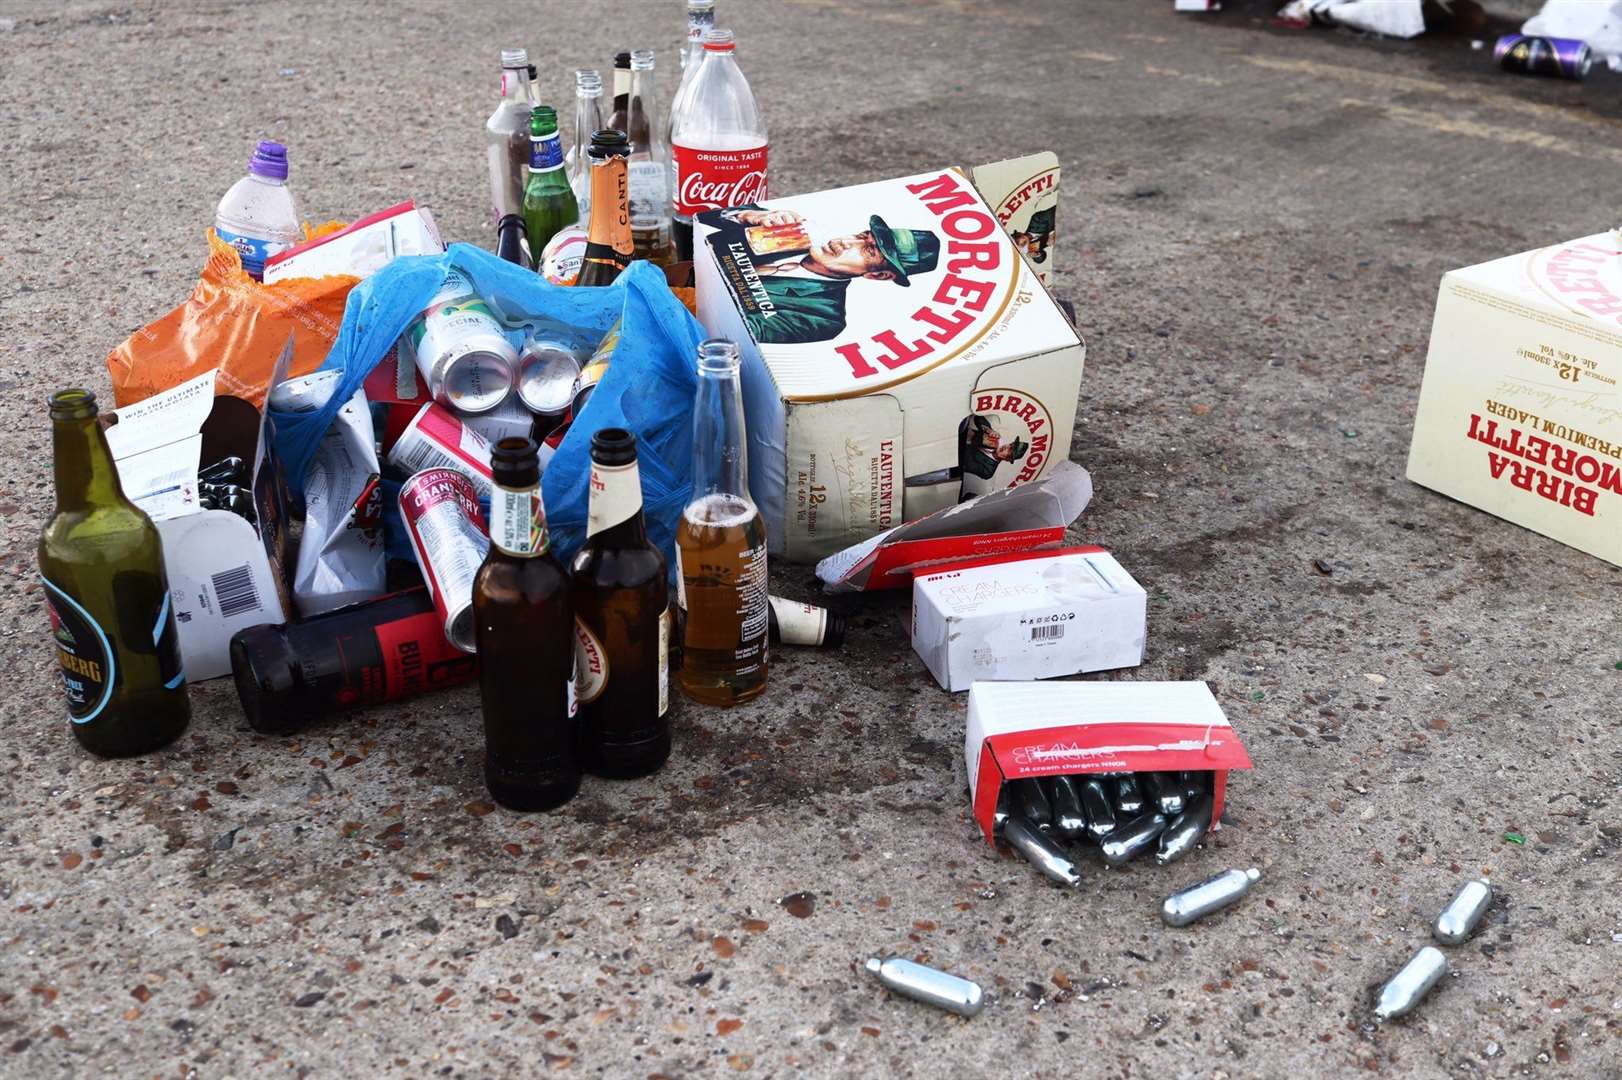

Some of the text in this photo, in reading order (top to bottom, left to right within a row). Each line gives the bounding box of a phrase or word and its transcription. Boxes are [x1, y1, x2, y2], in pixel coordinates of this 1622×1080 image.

[696, 152, 762, 162] ORIGINAL TASTE
[618, 173, 628, 226] CANTI
[728, 242, 778, 319] L'AUTENTICA
[835, 173, 1000, 378] MORETTI
[1016, 289, 1033, 304] 12
[1523, 350, 1551, 365] 330ml
[1539, 344, 1554, 356] Vol.
[1559, 362, 1582, 382] 12
[1581, 358, 1598, 369] Alc.
[975, 394, 1045, 434] BIRRA
[1486, 399, 1622, 459] PREMIUM LAGER
[879, 440, 893, 532] L'AUTENTICA
[1488, 451, 1599, 516] BIRRA
[809, 484, 826, 504] 12
[870, 492, 878, 506] DAL
[1032, 764, 1061, 772] cream
[1062, 762, 1100, 770] chargers
